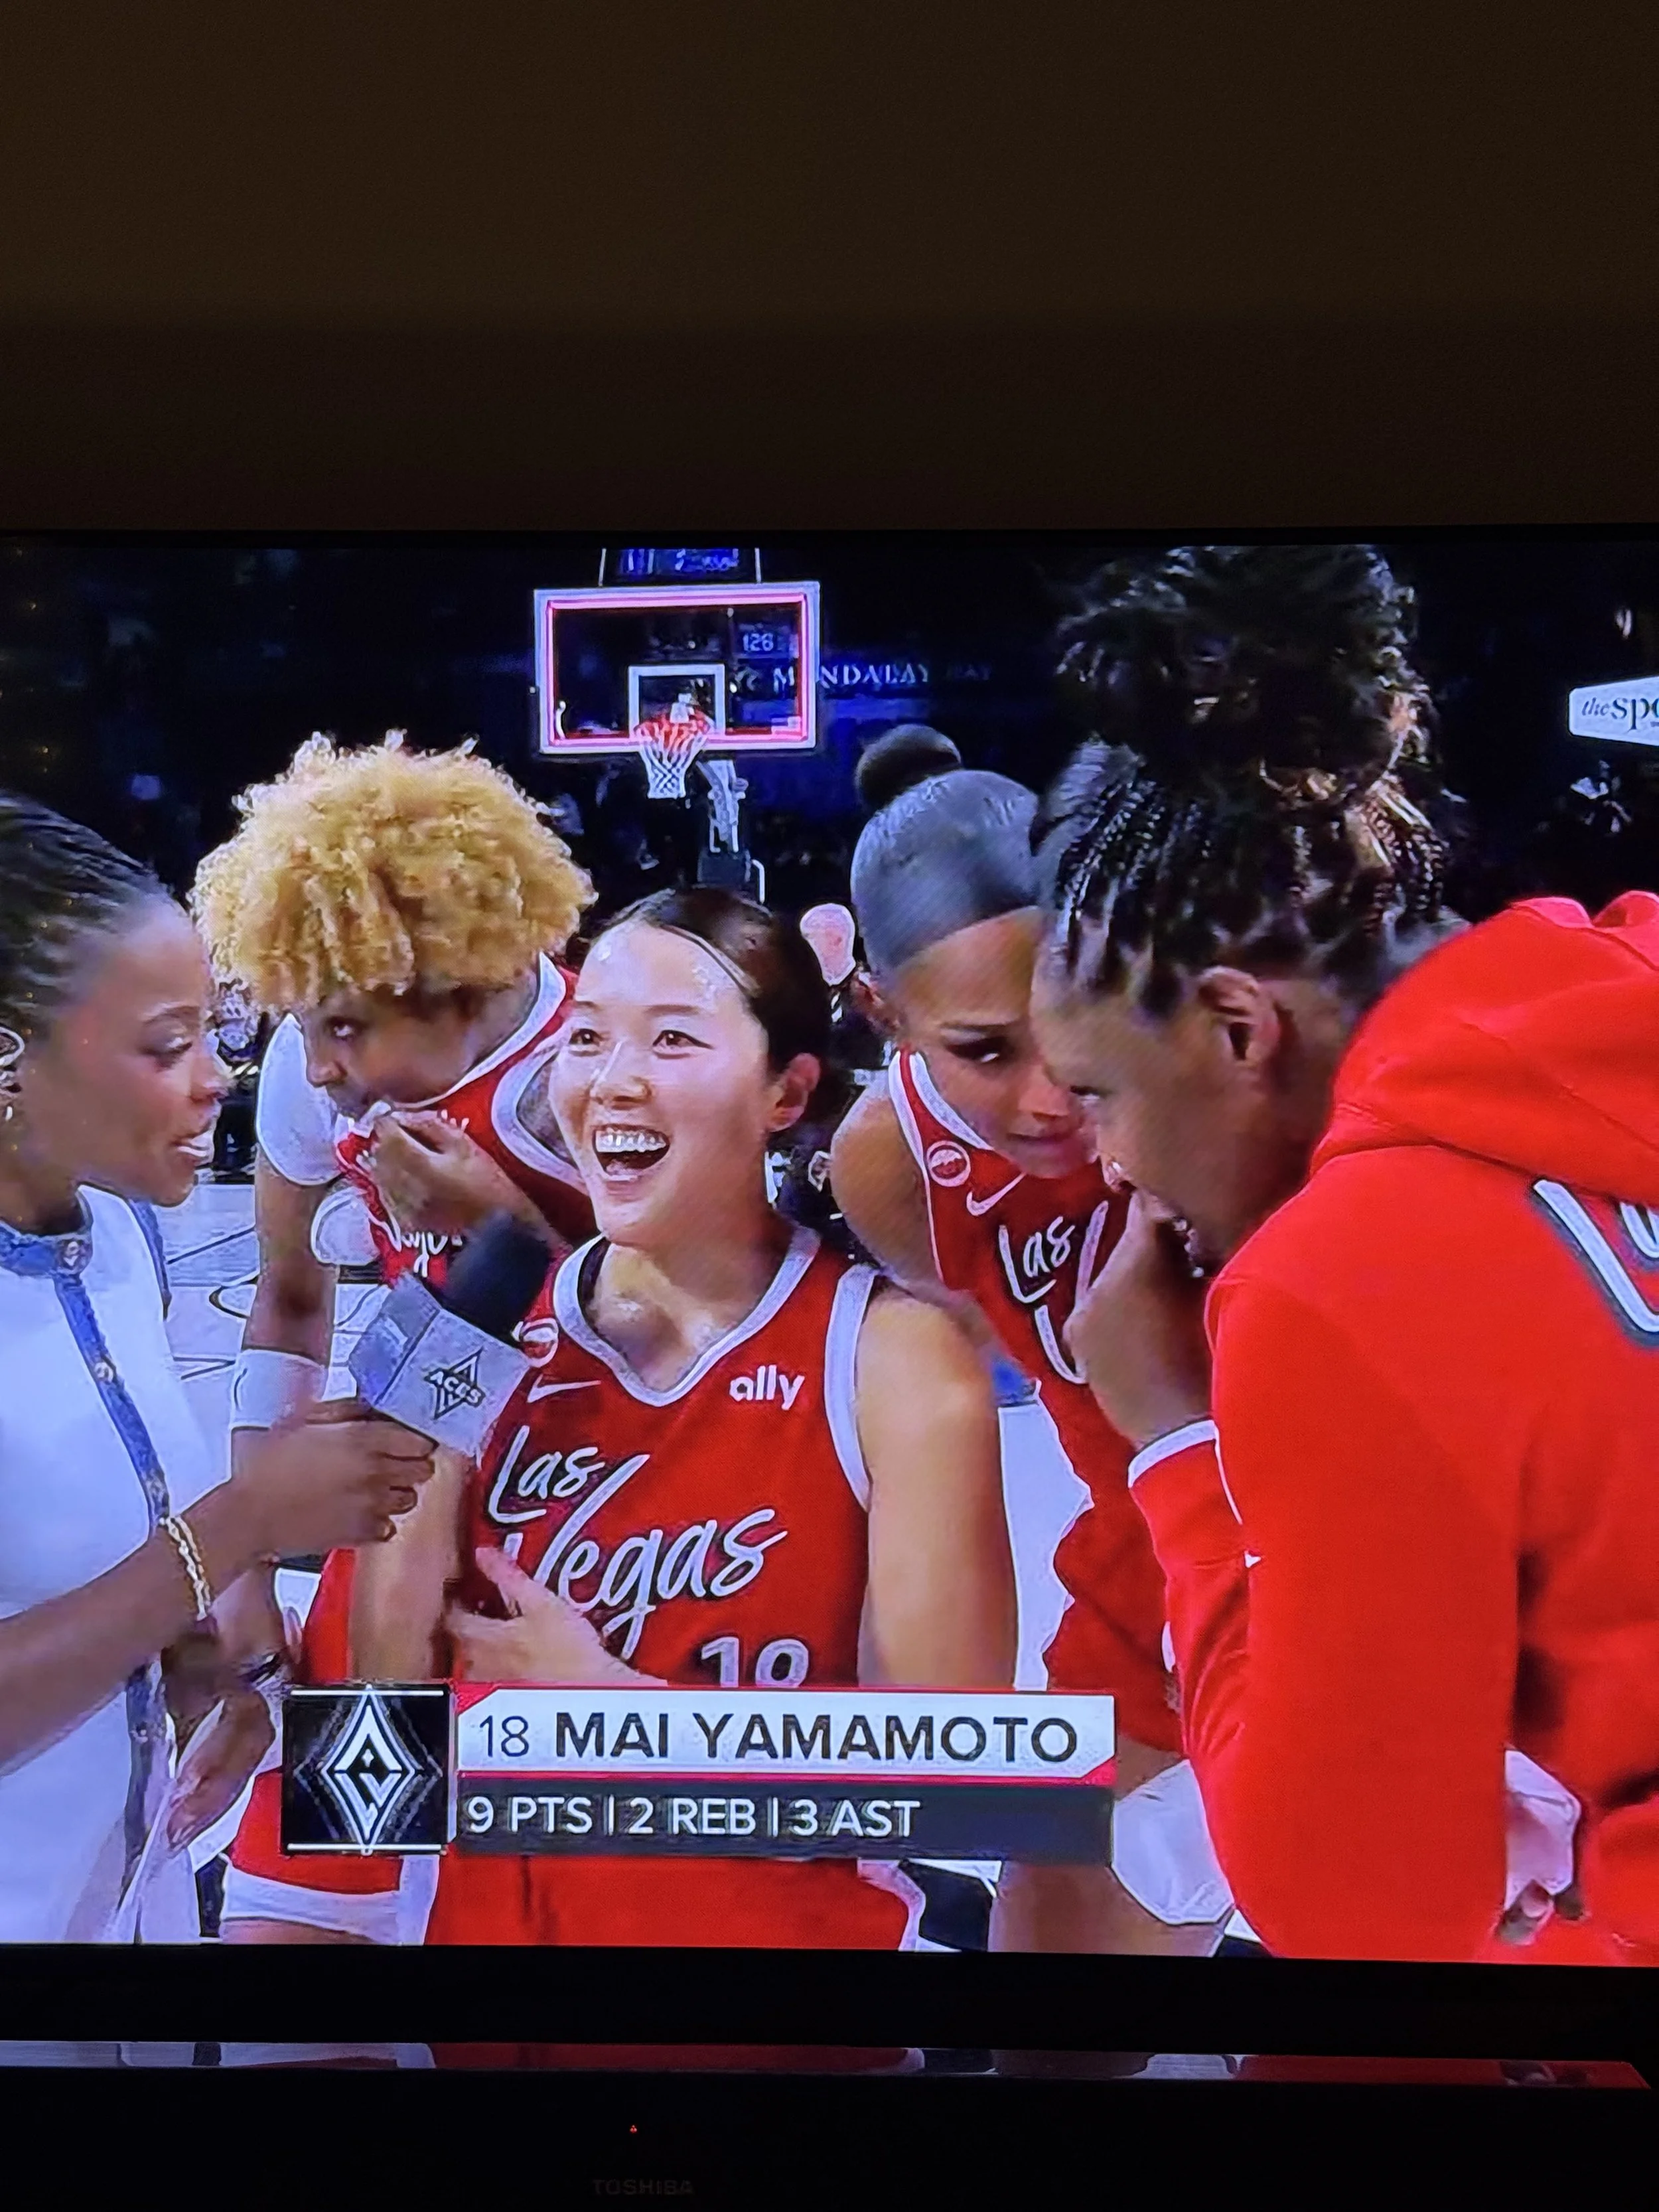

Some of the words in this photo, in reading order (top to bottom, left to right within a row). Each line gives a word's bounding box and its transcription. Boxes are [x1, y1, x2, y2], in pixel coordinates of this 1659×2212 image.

[772, 664, 928, 693] MNDALAY
[998, 1217, 1075, 1303] Las
[730, 1364, 805, 1411] ally
[488, 1426, 605, 1523] Las
[479, 1715, 530, 1757] 18
[555, 1712, 670, 1758] MAI
[693, 1712, 1078, 1763] YAMAMOTO
[466, 1797, 494, 1832] 9
[510, 1796, 593, 1834] PTS
[628, 1797, 654, 1834] 2
[672, 1797, 756, 1836] REB
[793, 1799, 819, 1836] 3
[830, 1799, 921, 1838] AST
[593, 2179, 694, 2195] TOSHIBA
